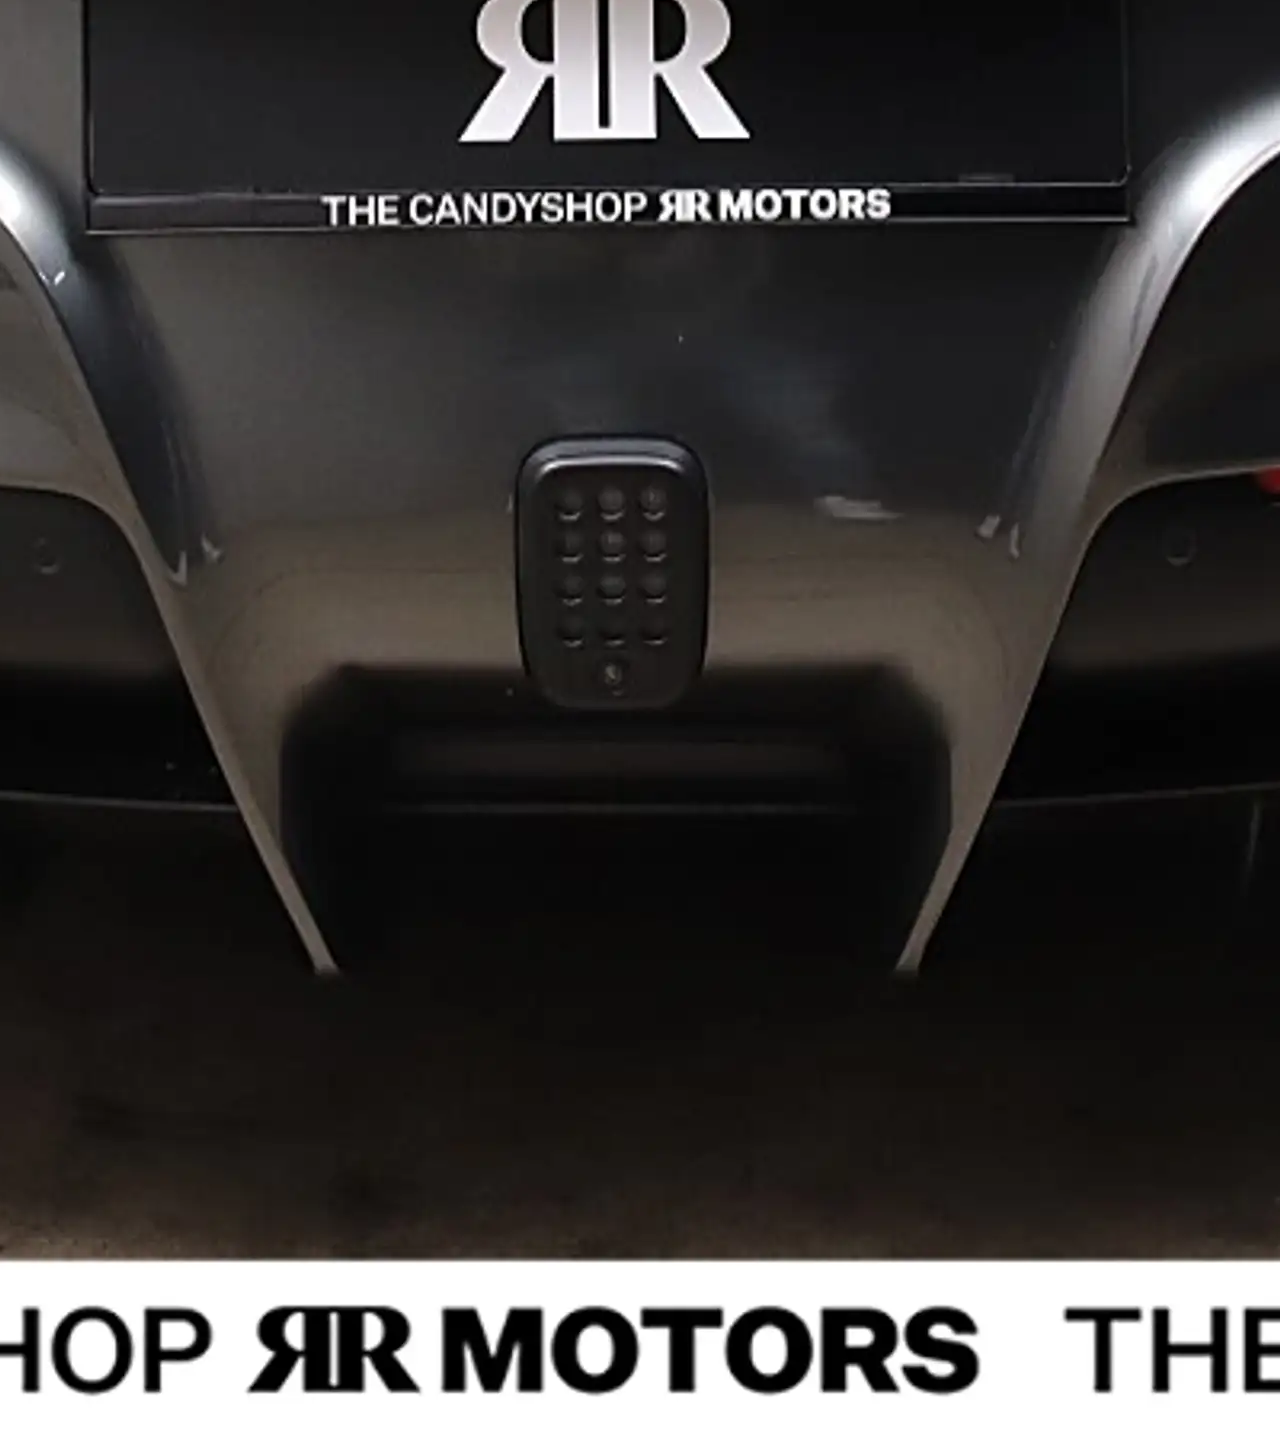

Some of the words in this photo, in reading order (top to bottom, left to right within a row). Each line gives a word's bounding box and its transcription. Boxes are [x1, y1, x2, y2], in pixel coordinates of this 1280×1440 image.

[320, 194, 401, 227] THE
[408, 190, 648, 226] CANDYSHOP
[719, 187, 892, 222] MOTORS
